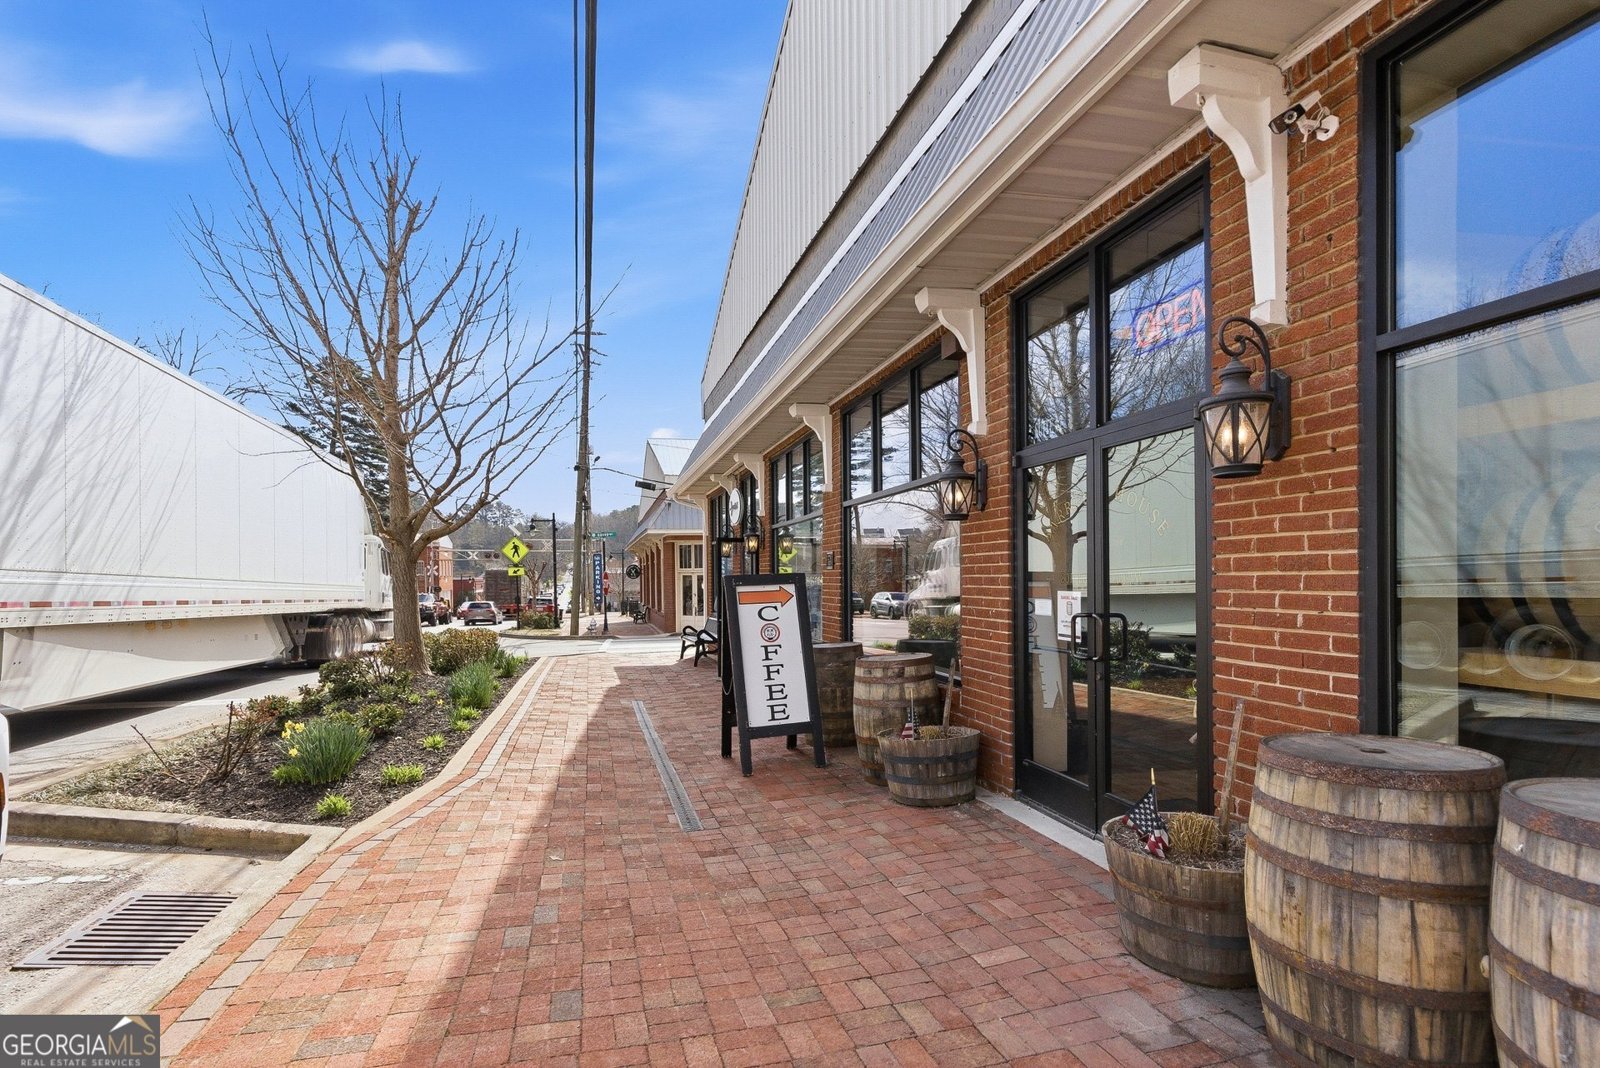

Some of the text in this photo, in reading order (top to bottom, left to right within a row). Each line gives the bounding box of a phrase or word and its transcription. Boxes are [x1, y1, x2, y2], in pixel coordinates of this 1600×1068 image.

[1136, 288, 1205, 348] OPEN
[594, 560, 602, 594] PARKING
[757, 605, 790, 722] COFFEE
